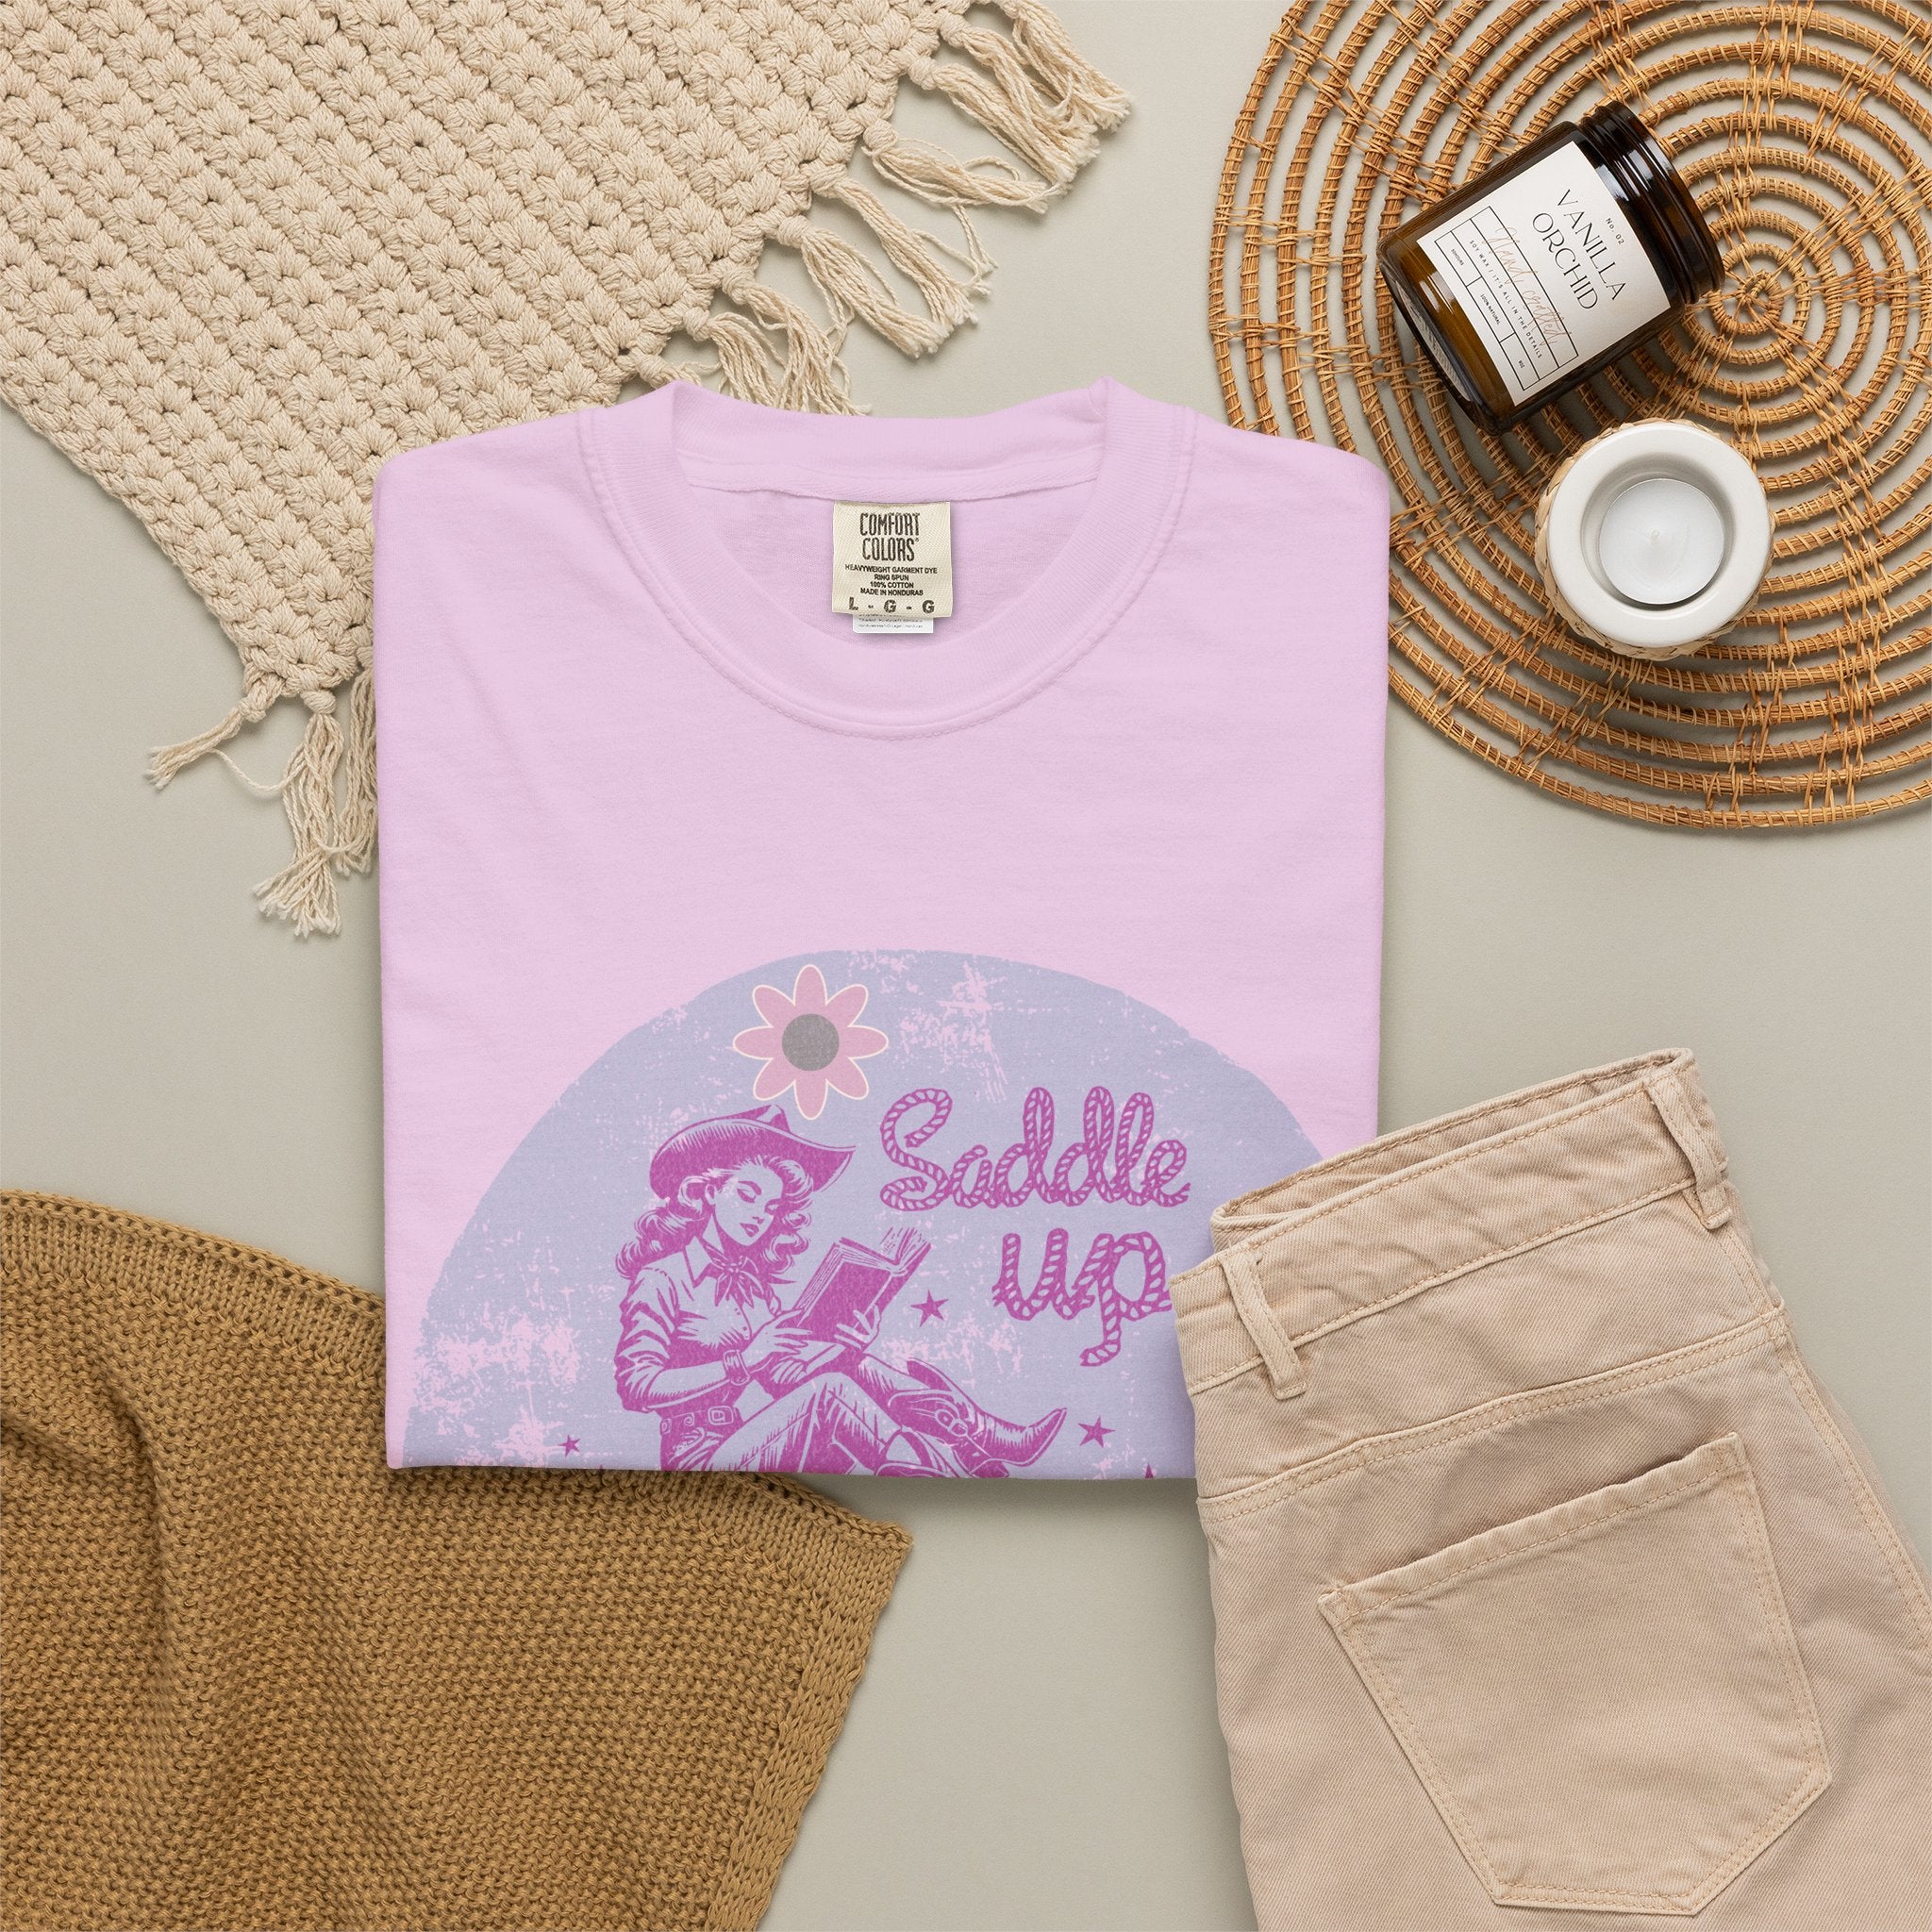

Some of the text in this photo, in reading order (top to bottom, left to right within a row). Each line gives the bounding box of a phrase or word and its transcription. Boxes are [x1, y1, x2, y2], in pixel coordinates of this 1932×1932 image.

[1557, 189, 1627, 301] VANILLA
[1615, 233, 1624, 244] 02
[1532, 212, 1599, 309] ORCHID
[1469, 240, 1479, 252] SOY
[1478, 254, 1490, 267] WAX
[1503, 291, 1511, 304] ALL
[1511, 306, 1519, 315] IN
[1518, 316, 1527, 330] THE
[1525, 331, 1542, 358] DETAILS
[1488, 305, 1501, 325] NATURAL
[859, 512, 921, 536] COMFORT
[844, 564, 891, 574] HEAVYWEIGHT
[891, 566, 924, 575] GARMENT
[859, 587, 879, 595] MADE
[848, 596, 858, 610] L
[883, 599, 897, 613] G
[922, 599, 935, 613] G
[879, 1086, 1191, 1211] Saddle
[991, 1227, 1173, 1367] up
